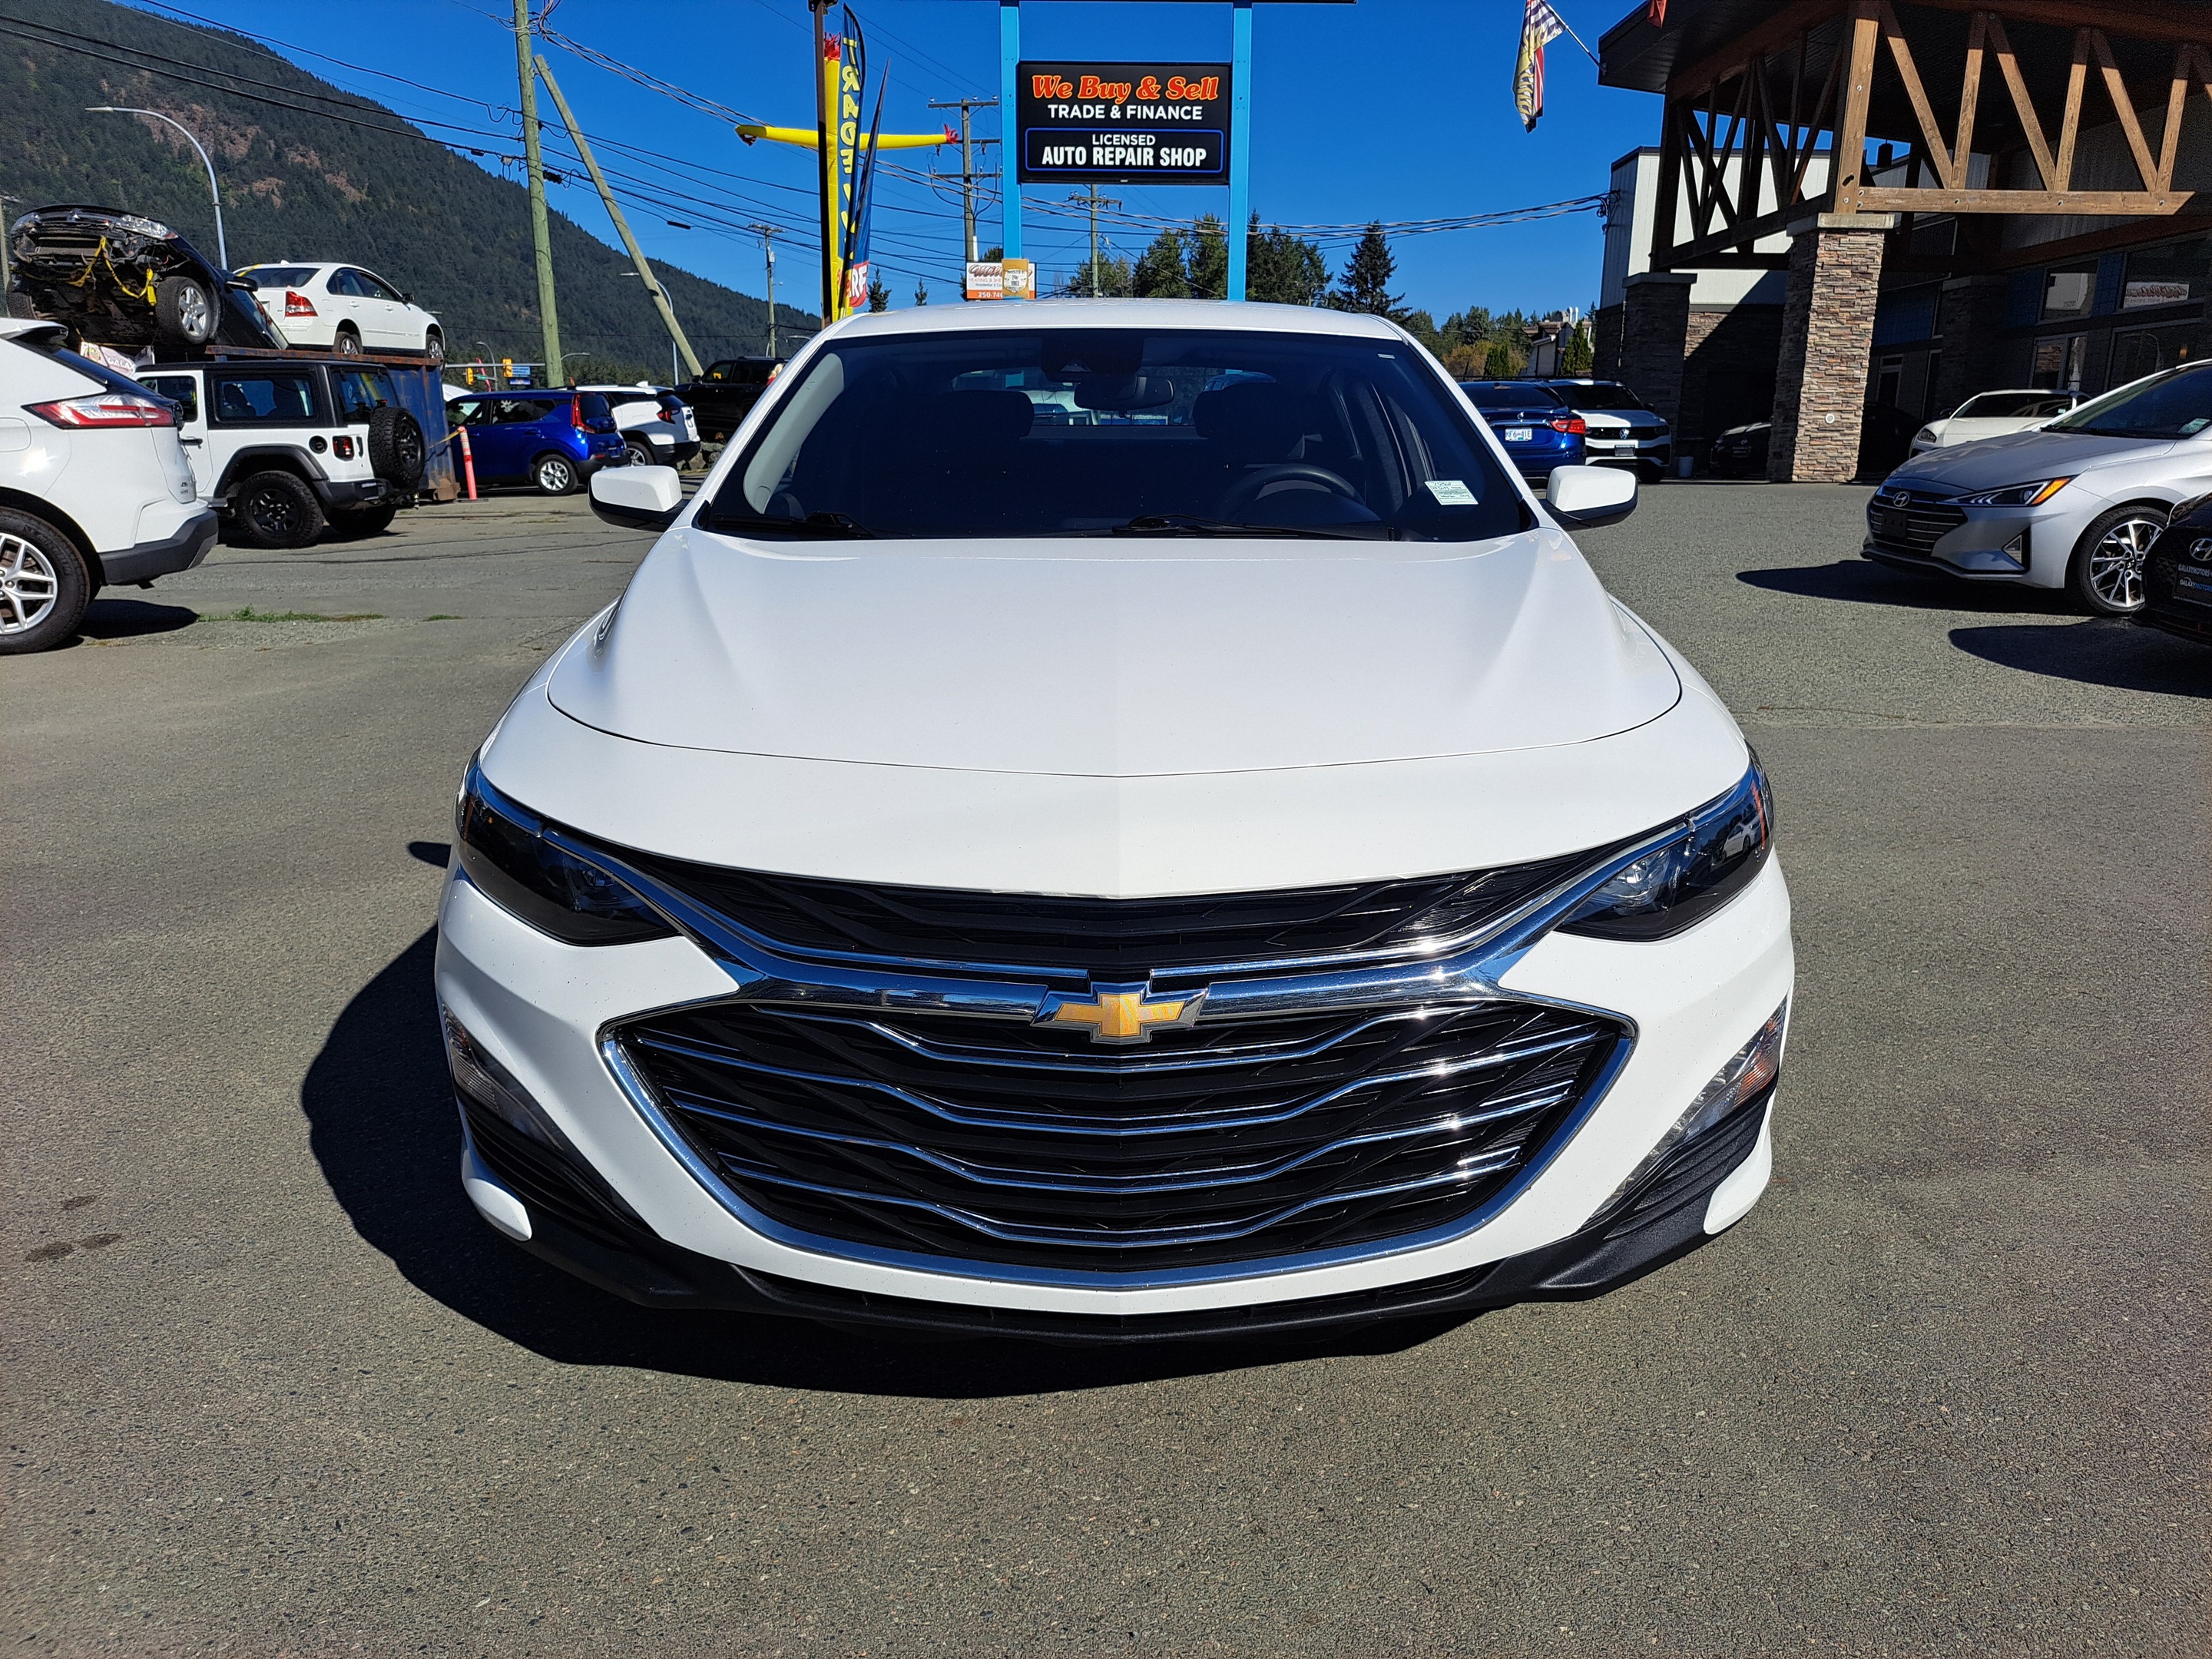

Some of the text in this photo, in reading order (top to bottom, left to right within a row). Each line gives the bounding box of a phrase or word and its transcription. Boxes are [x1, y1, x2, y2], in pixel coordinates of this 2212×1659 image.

[1031, 75, 1220, 105] We Buy & Sell
[1048, 104, 1203, 120] TRADE & FINANCE
[1092, 134, 1156, 146] LICENSED
[1041, 146, 1207, 167] AUTO REPAIR SHOP
